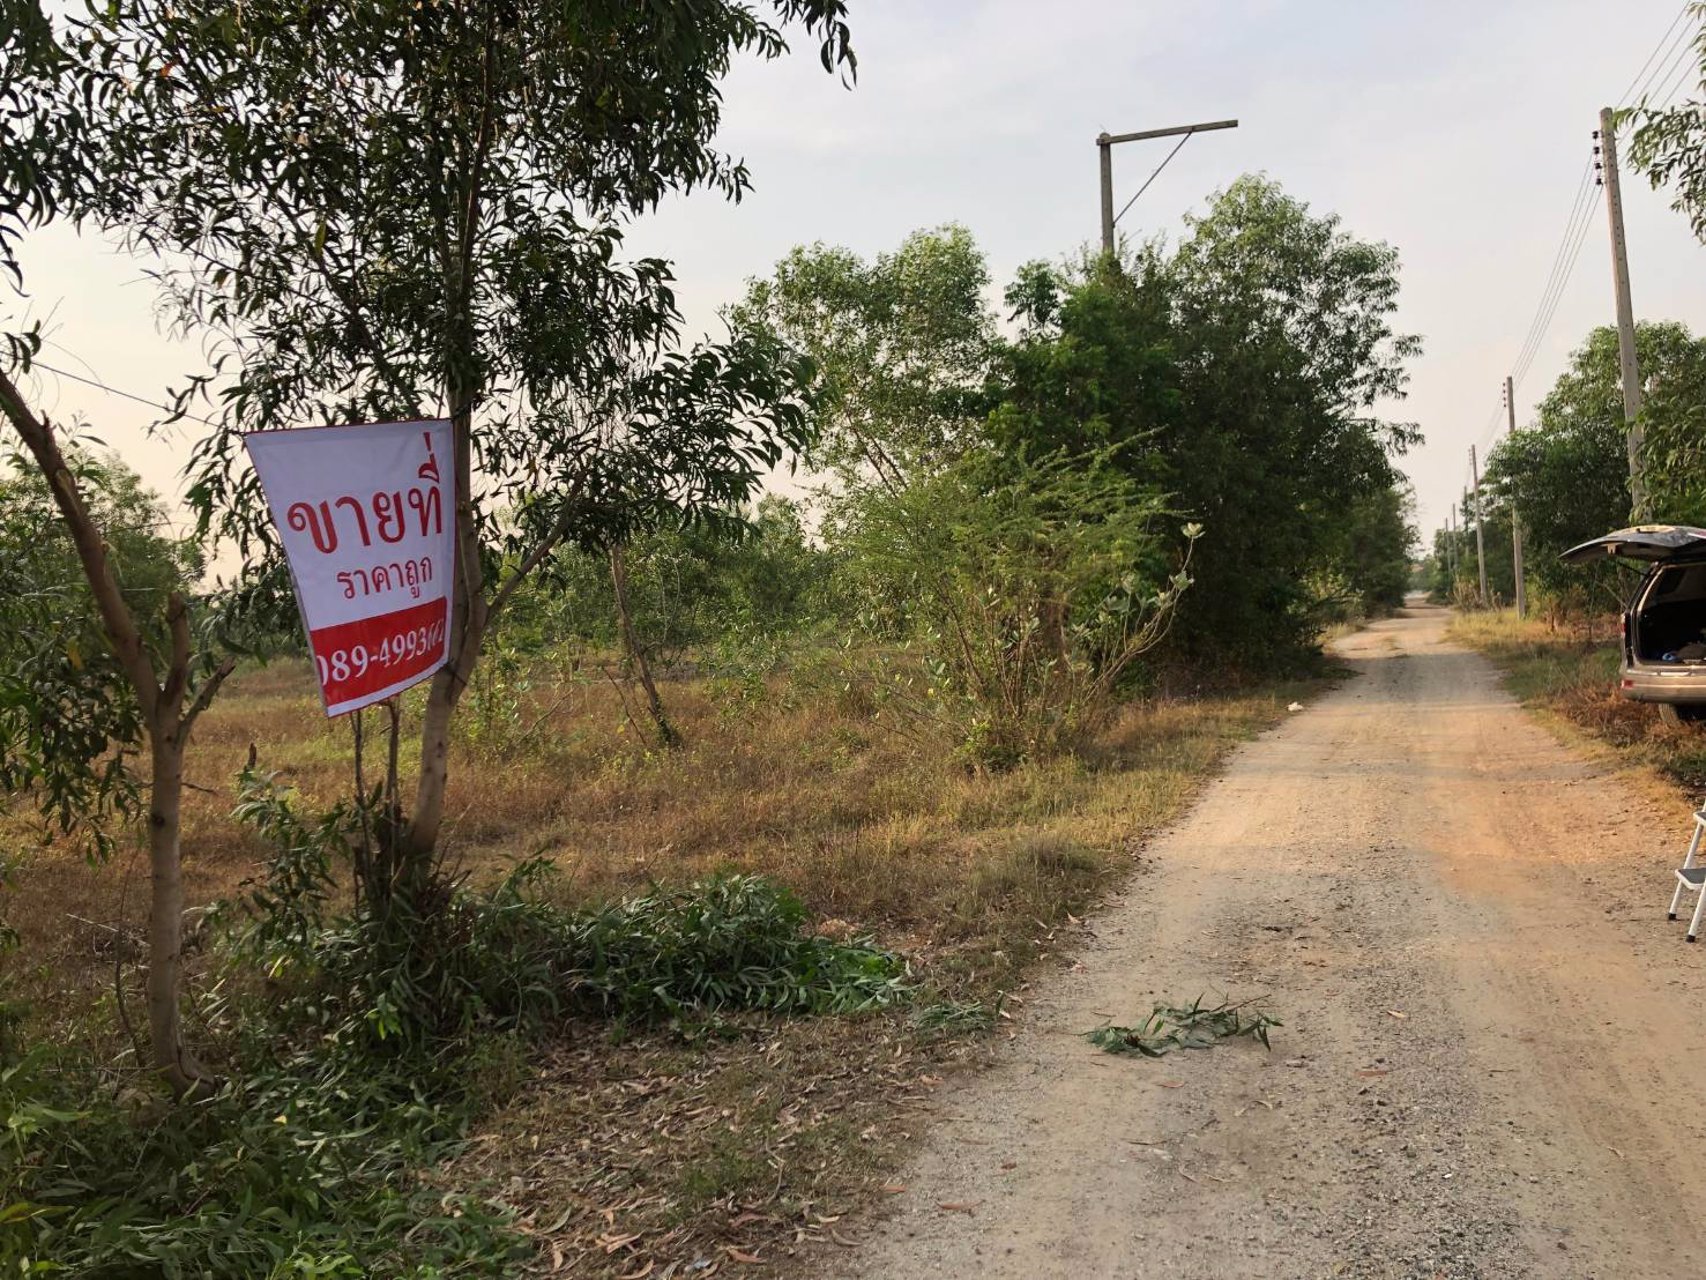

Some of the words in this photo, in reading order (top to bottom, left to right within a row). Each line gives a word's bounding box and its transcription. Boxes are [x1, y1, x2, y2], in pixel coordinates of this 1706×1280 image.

[287, 432, 442, 554] ขายที่
[337, 556, 432, 599] ราคาถูก
